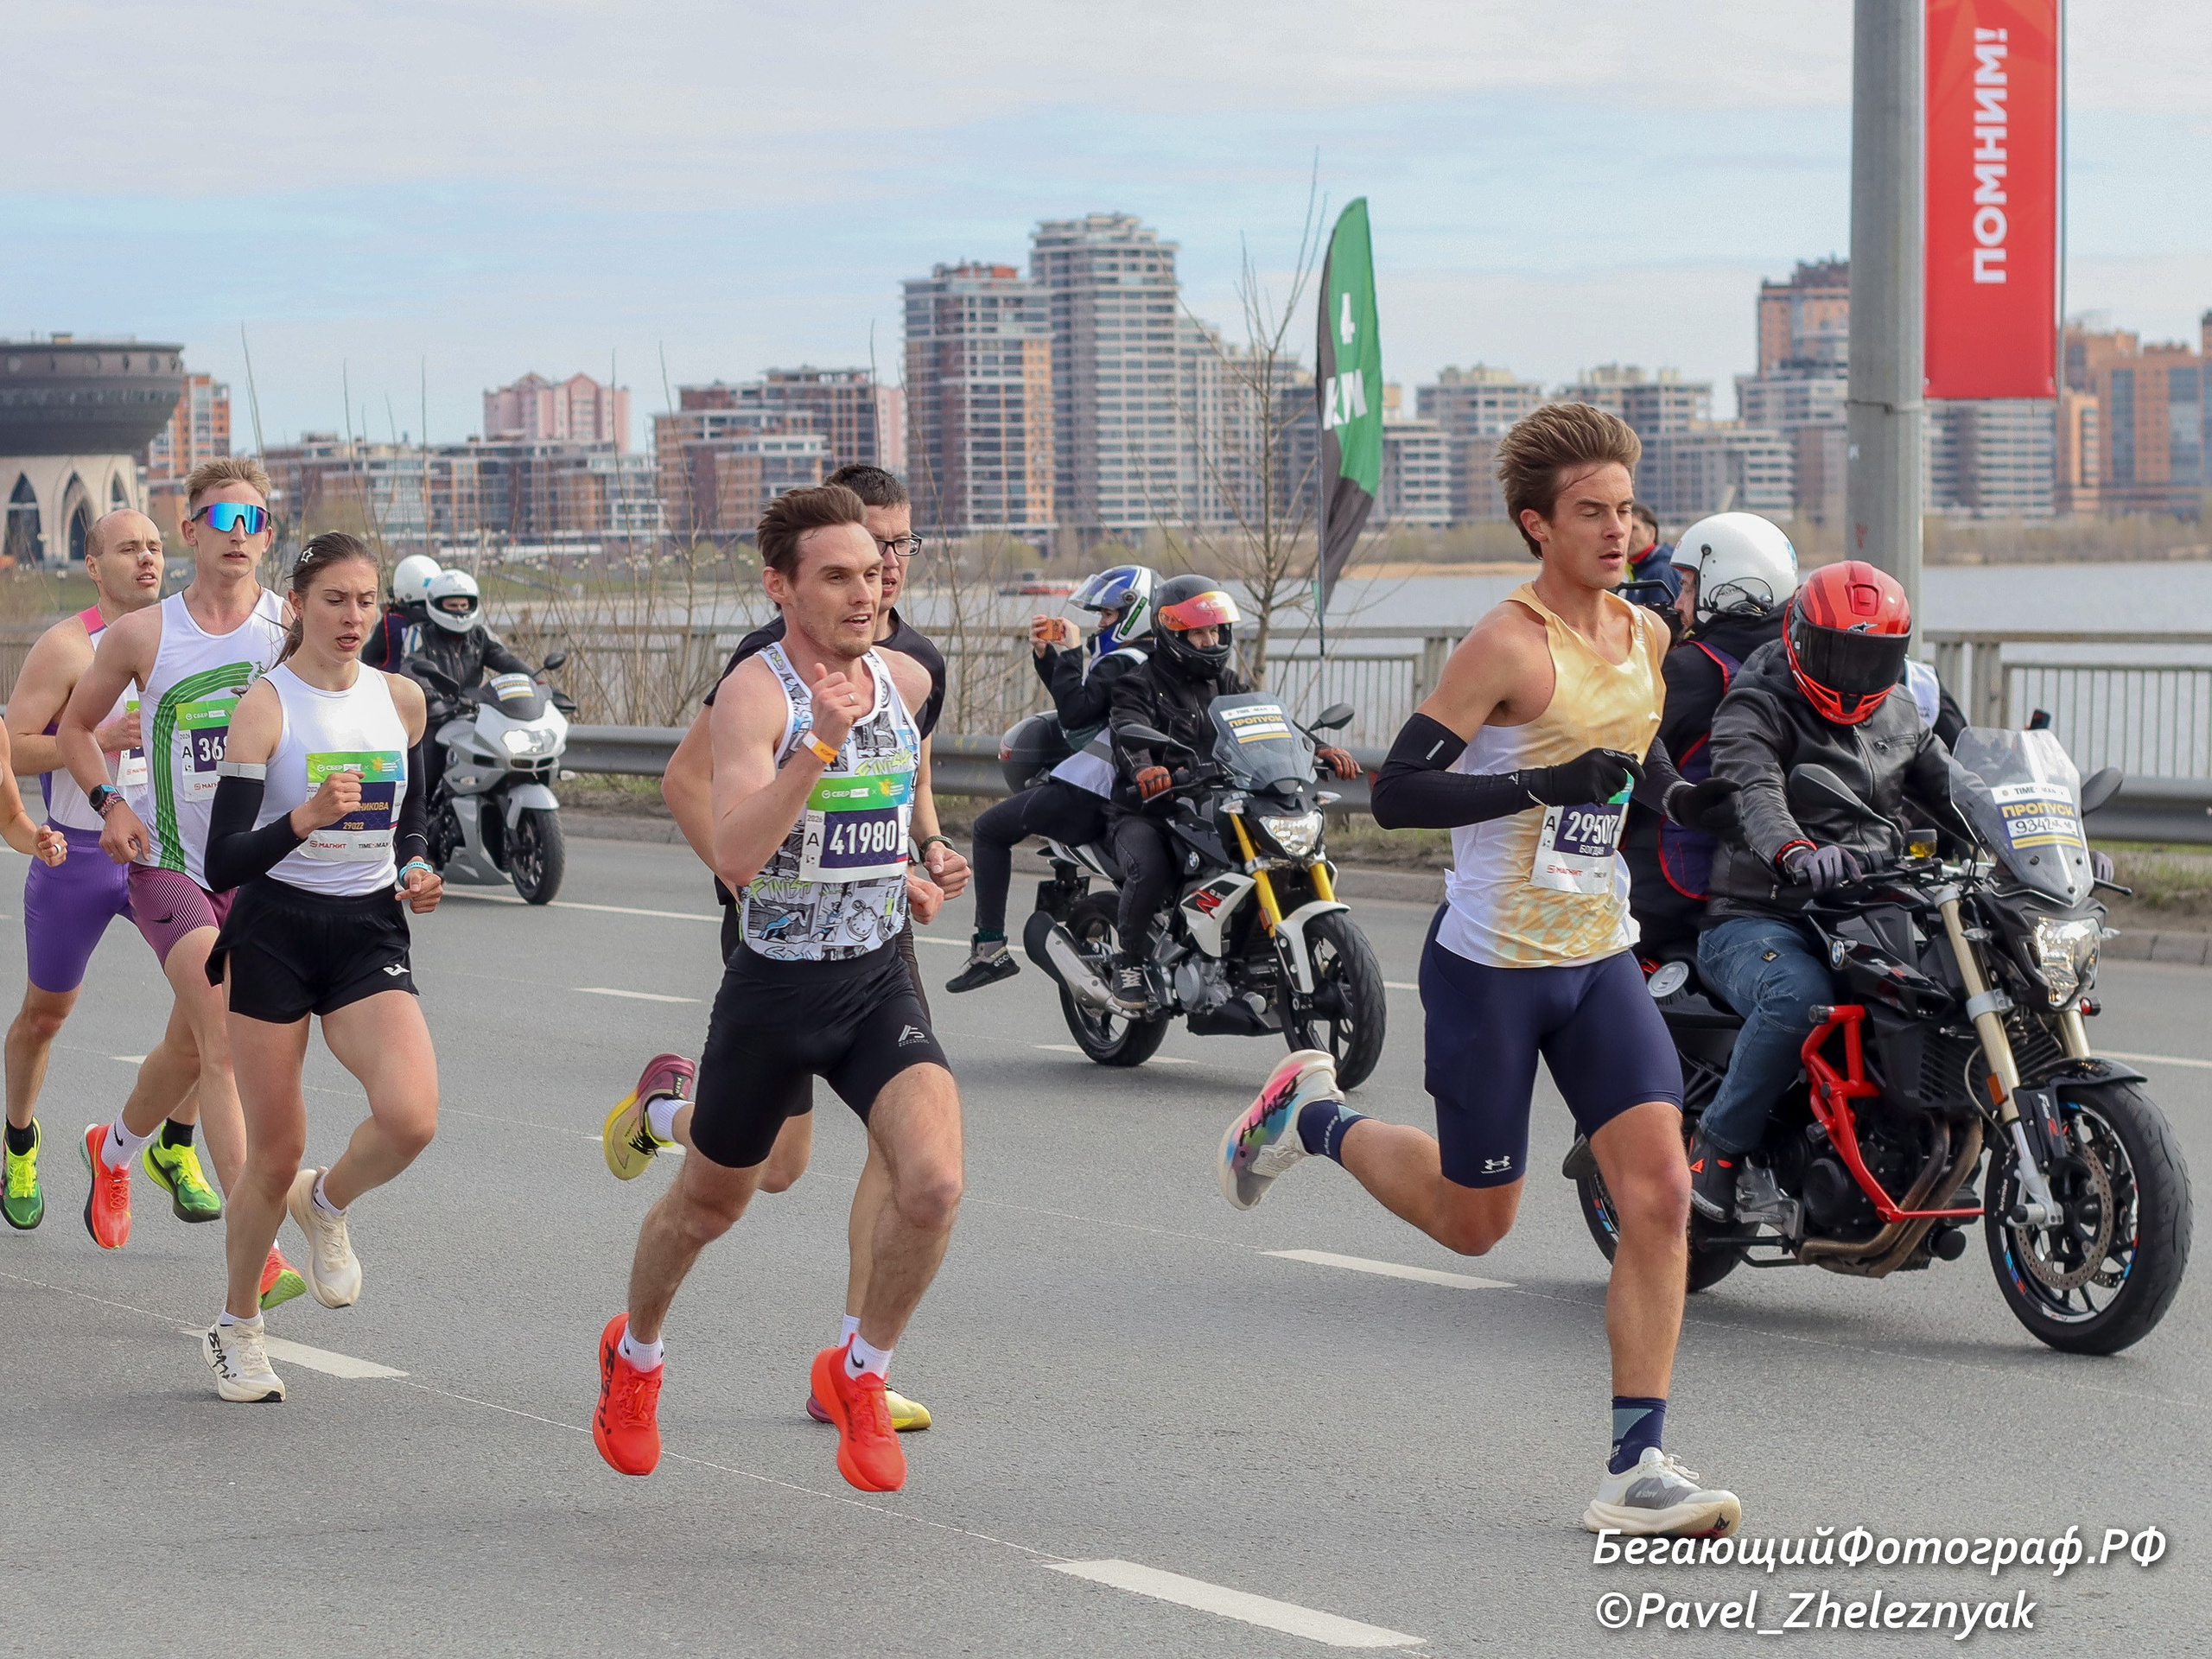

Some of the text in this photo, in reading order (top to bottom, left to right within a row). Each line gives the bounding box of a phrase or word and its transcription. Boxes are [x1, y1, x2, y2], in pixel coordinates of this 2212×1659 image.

[1973, 28, 2008, 283] ПОМНИМ!
[1228, 715, 1284, 728] ПРОПУСК
[198, 736, 227, 763] 36
[201, 781, 219, 790] МАГН
[2001, 802, 2075, 819] ПРОПУСК
[343, 822, 365, 830] 29022
[829, 819, 898, 855] 41980
[1564, 811, 1619, 844] 29507
